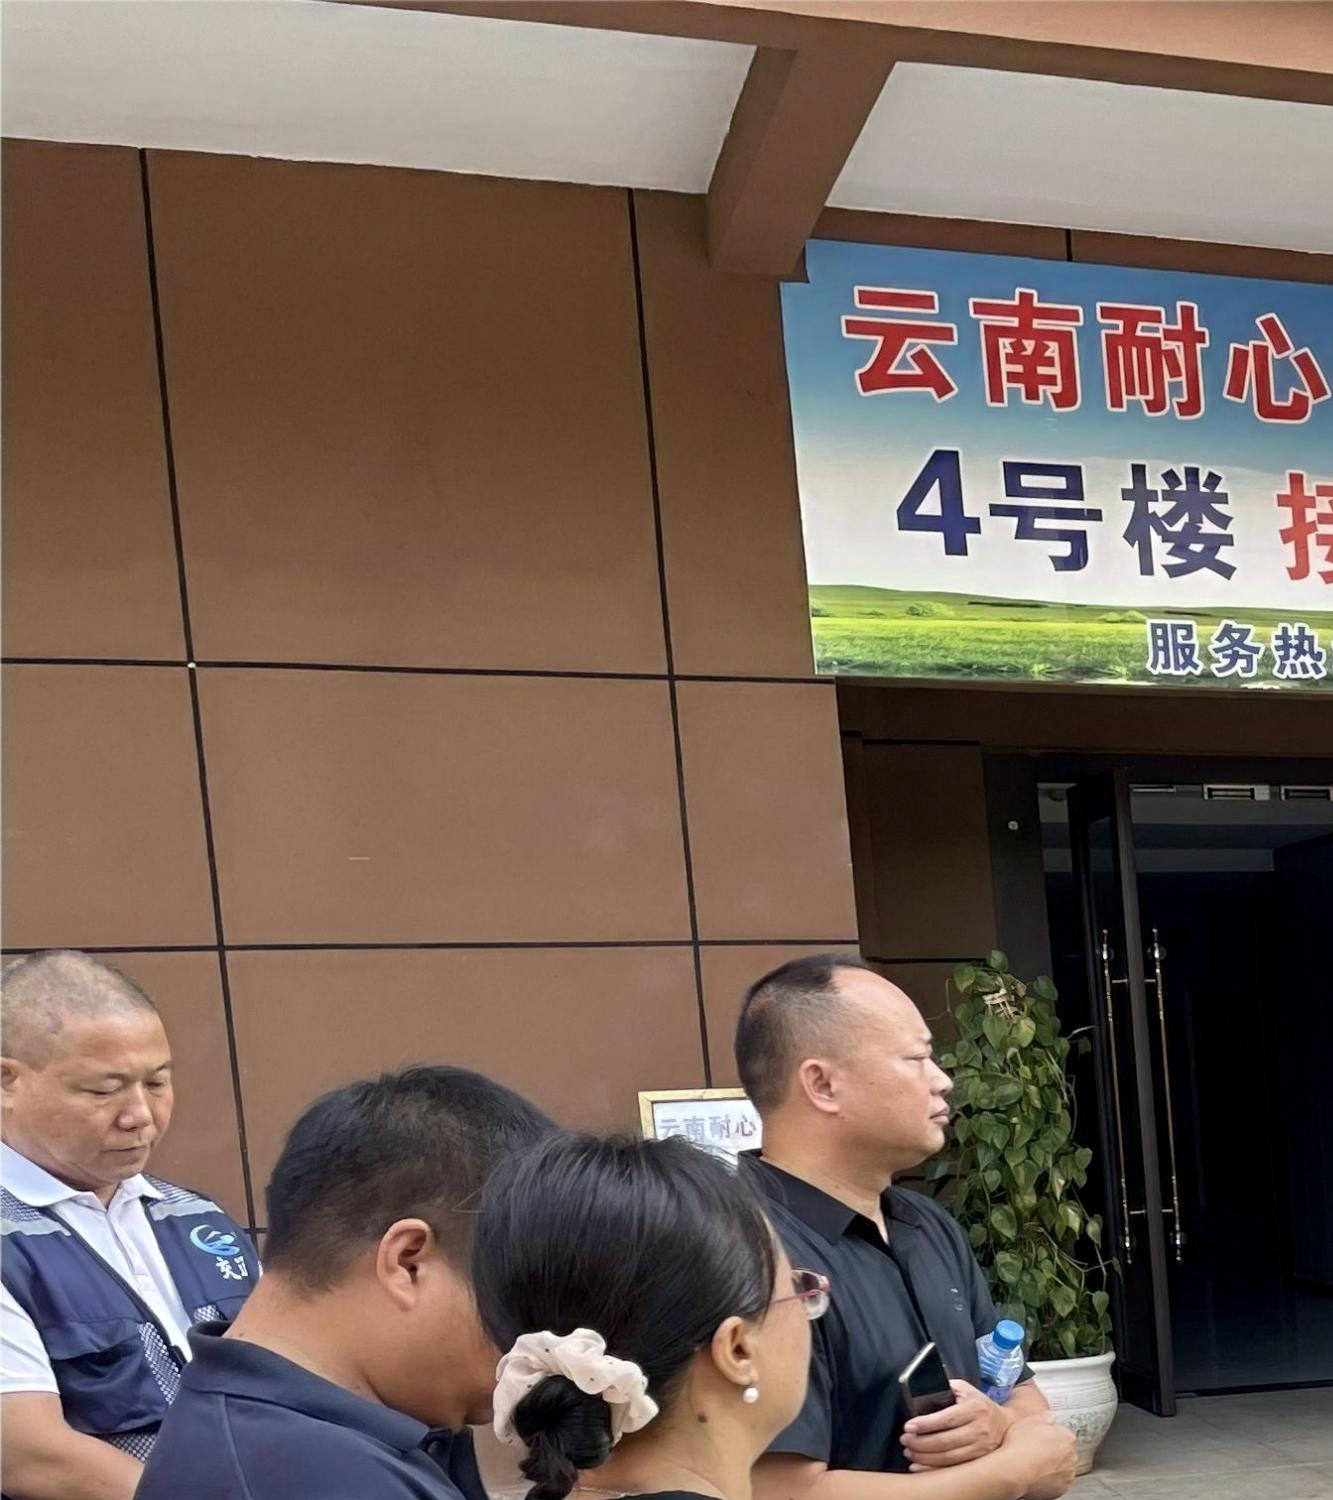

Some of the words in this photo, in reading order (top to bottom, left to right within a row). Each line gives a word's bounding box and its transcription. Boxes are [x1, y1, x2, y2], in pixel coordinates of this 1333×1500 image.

[896, 448, 1237, 581] 4号楼
[660, 1114, 757, 1142] 云南耐心
